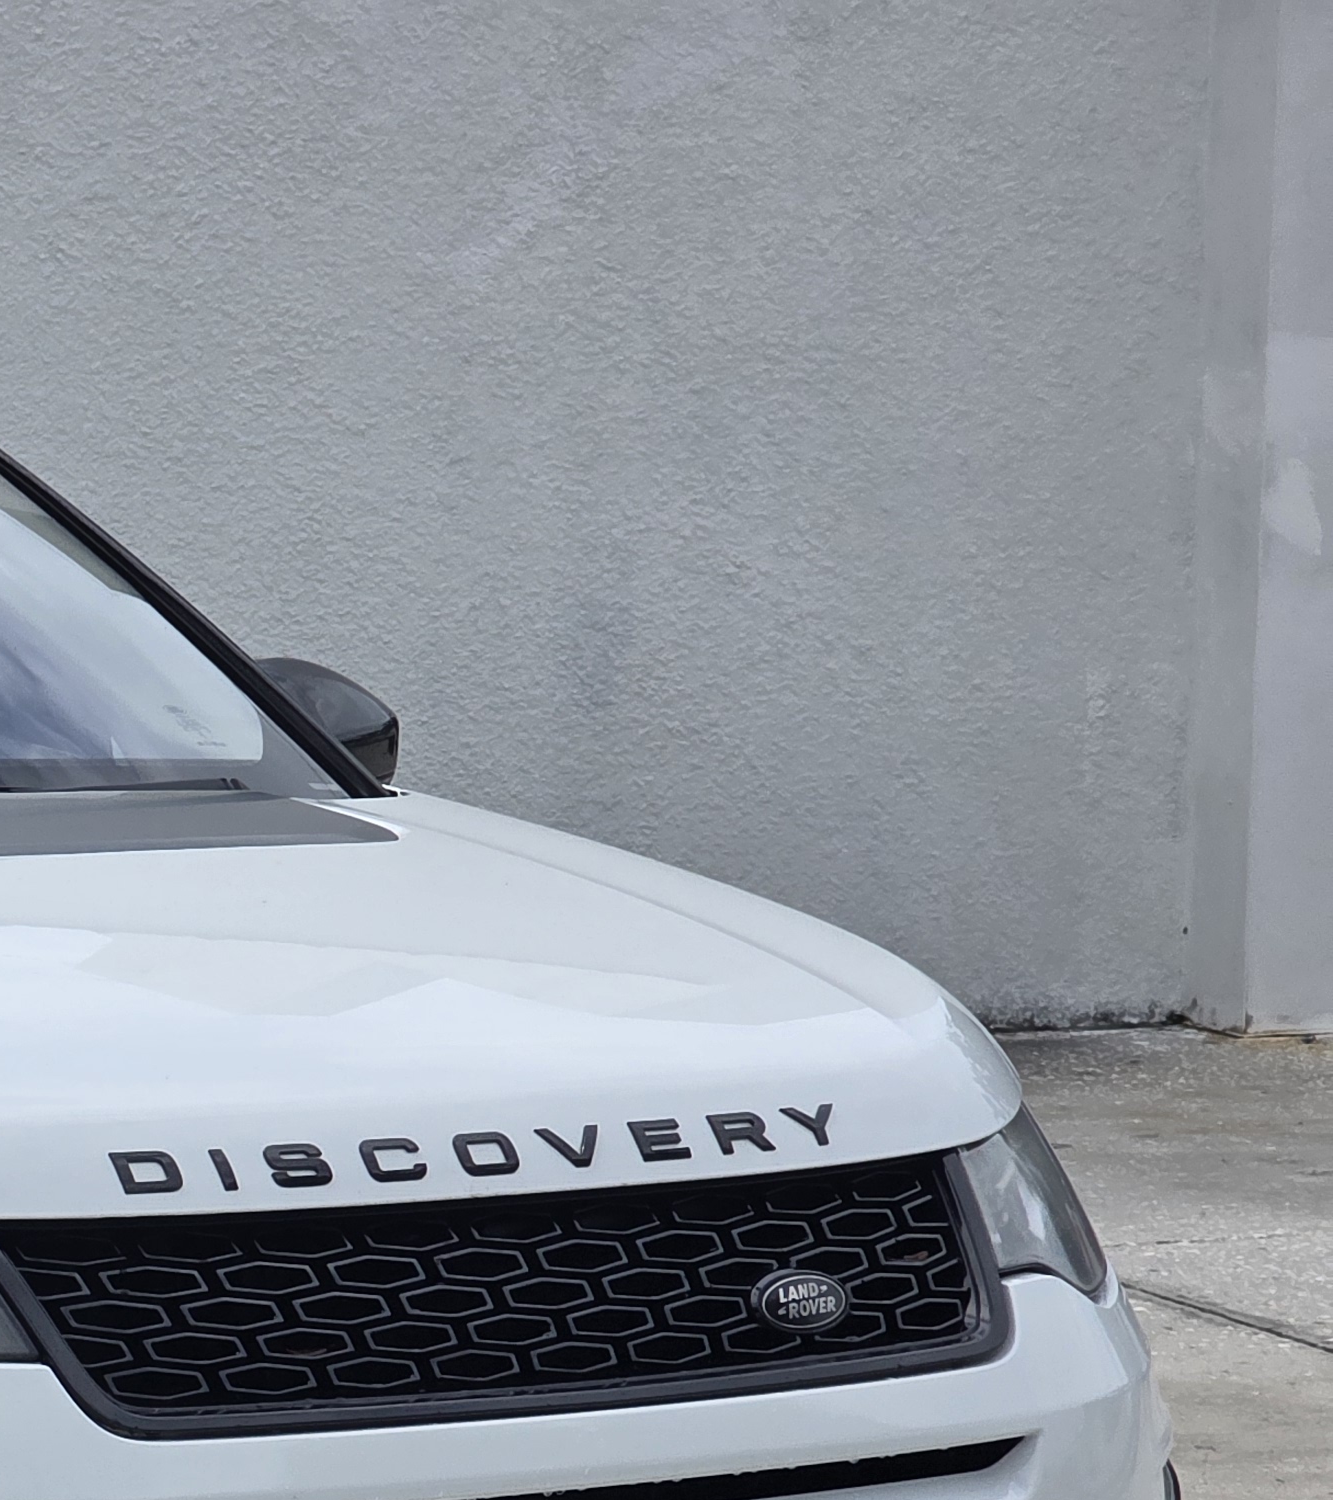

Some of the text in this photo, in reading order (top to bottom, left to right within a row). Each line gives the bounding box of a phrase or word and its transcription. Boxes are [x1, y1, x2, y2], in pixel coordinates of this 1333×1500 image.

[109, 1103, 833, 1195] DISCOVERY
[779, 1283, 819, 1303] LAND
[789, 1297, 836, 1319] ROVER
